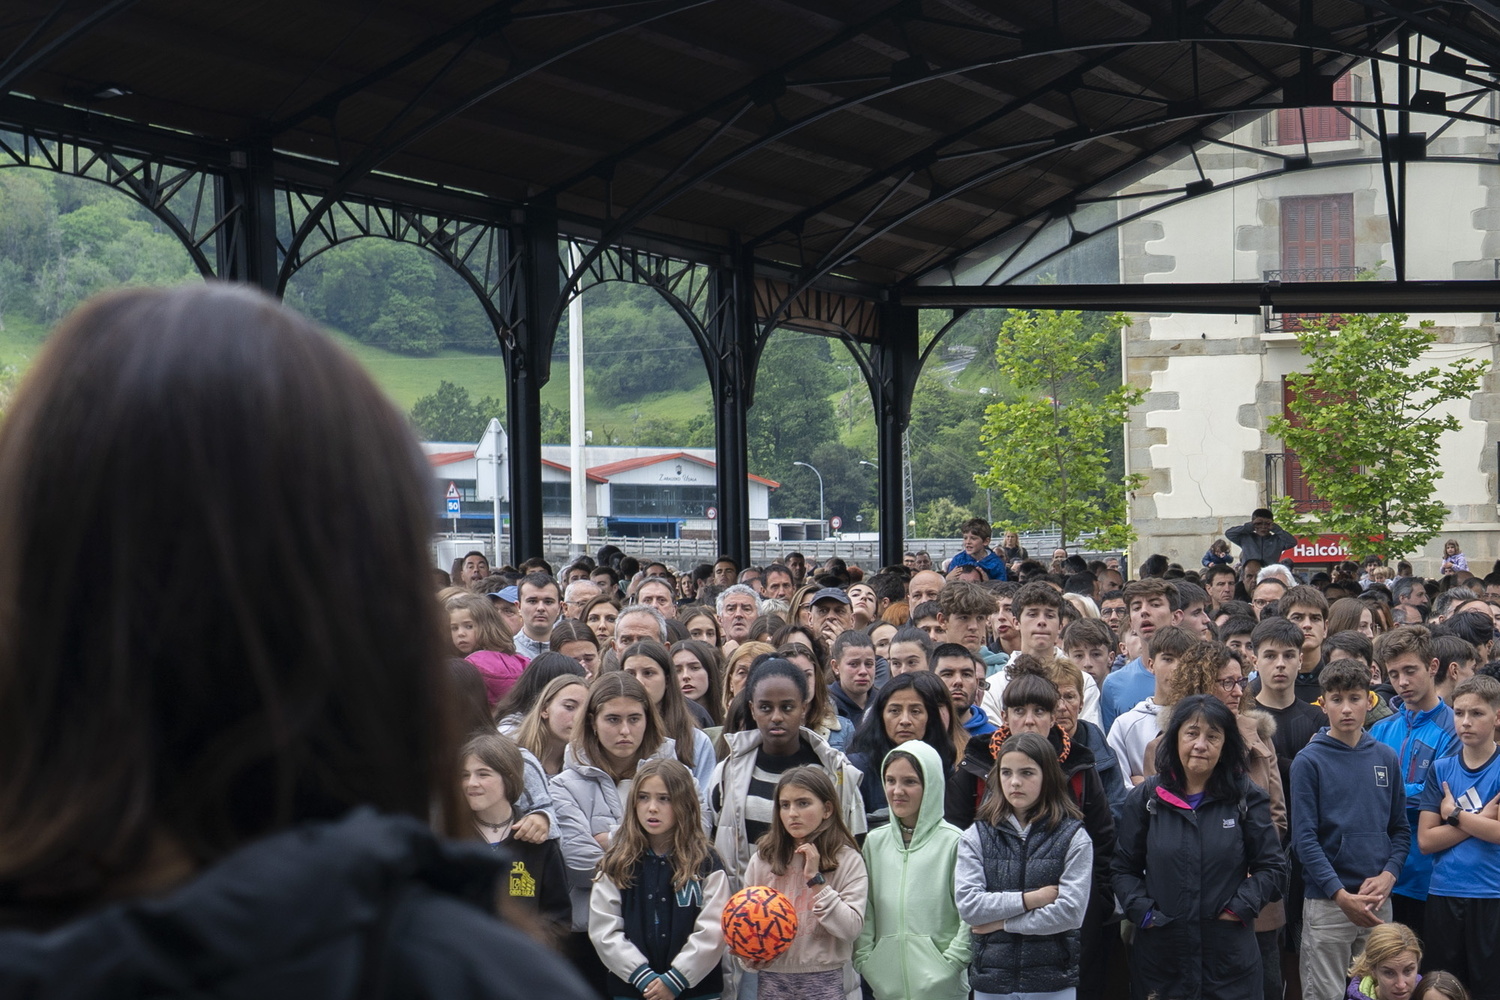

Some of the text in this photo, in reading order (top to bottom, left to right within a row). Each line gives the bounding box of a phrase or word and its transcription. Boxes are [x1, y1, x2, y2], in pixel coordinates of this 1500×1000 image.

[448, 502, 459, 511] 50
[512, 861, 525, 871] 50
[674, 877, 704, 907] W
